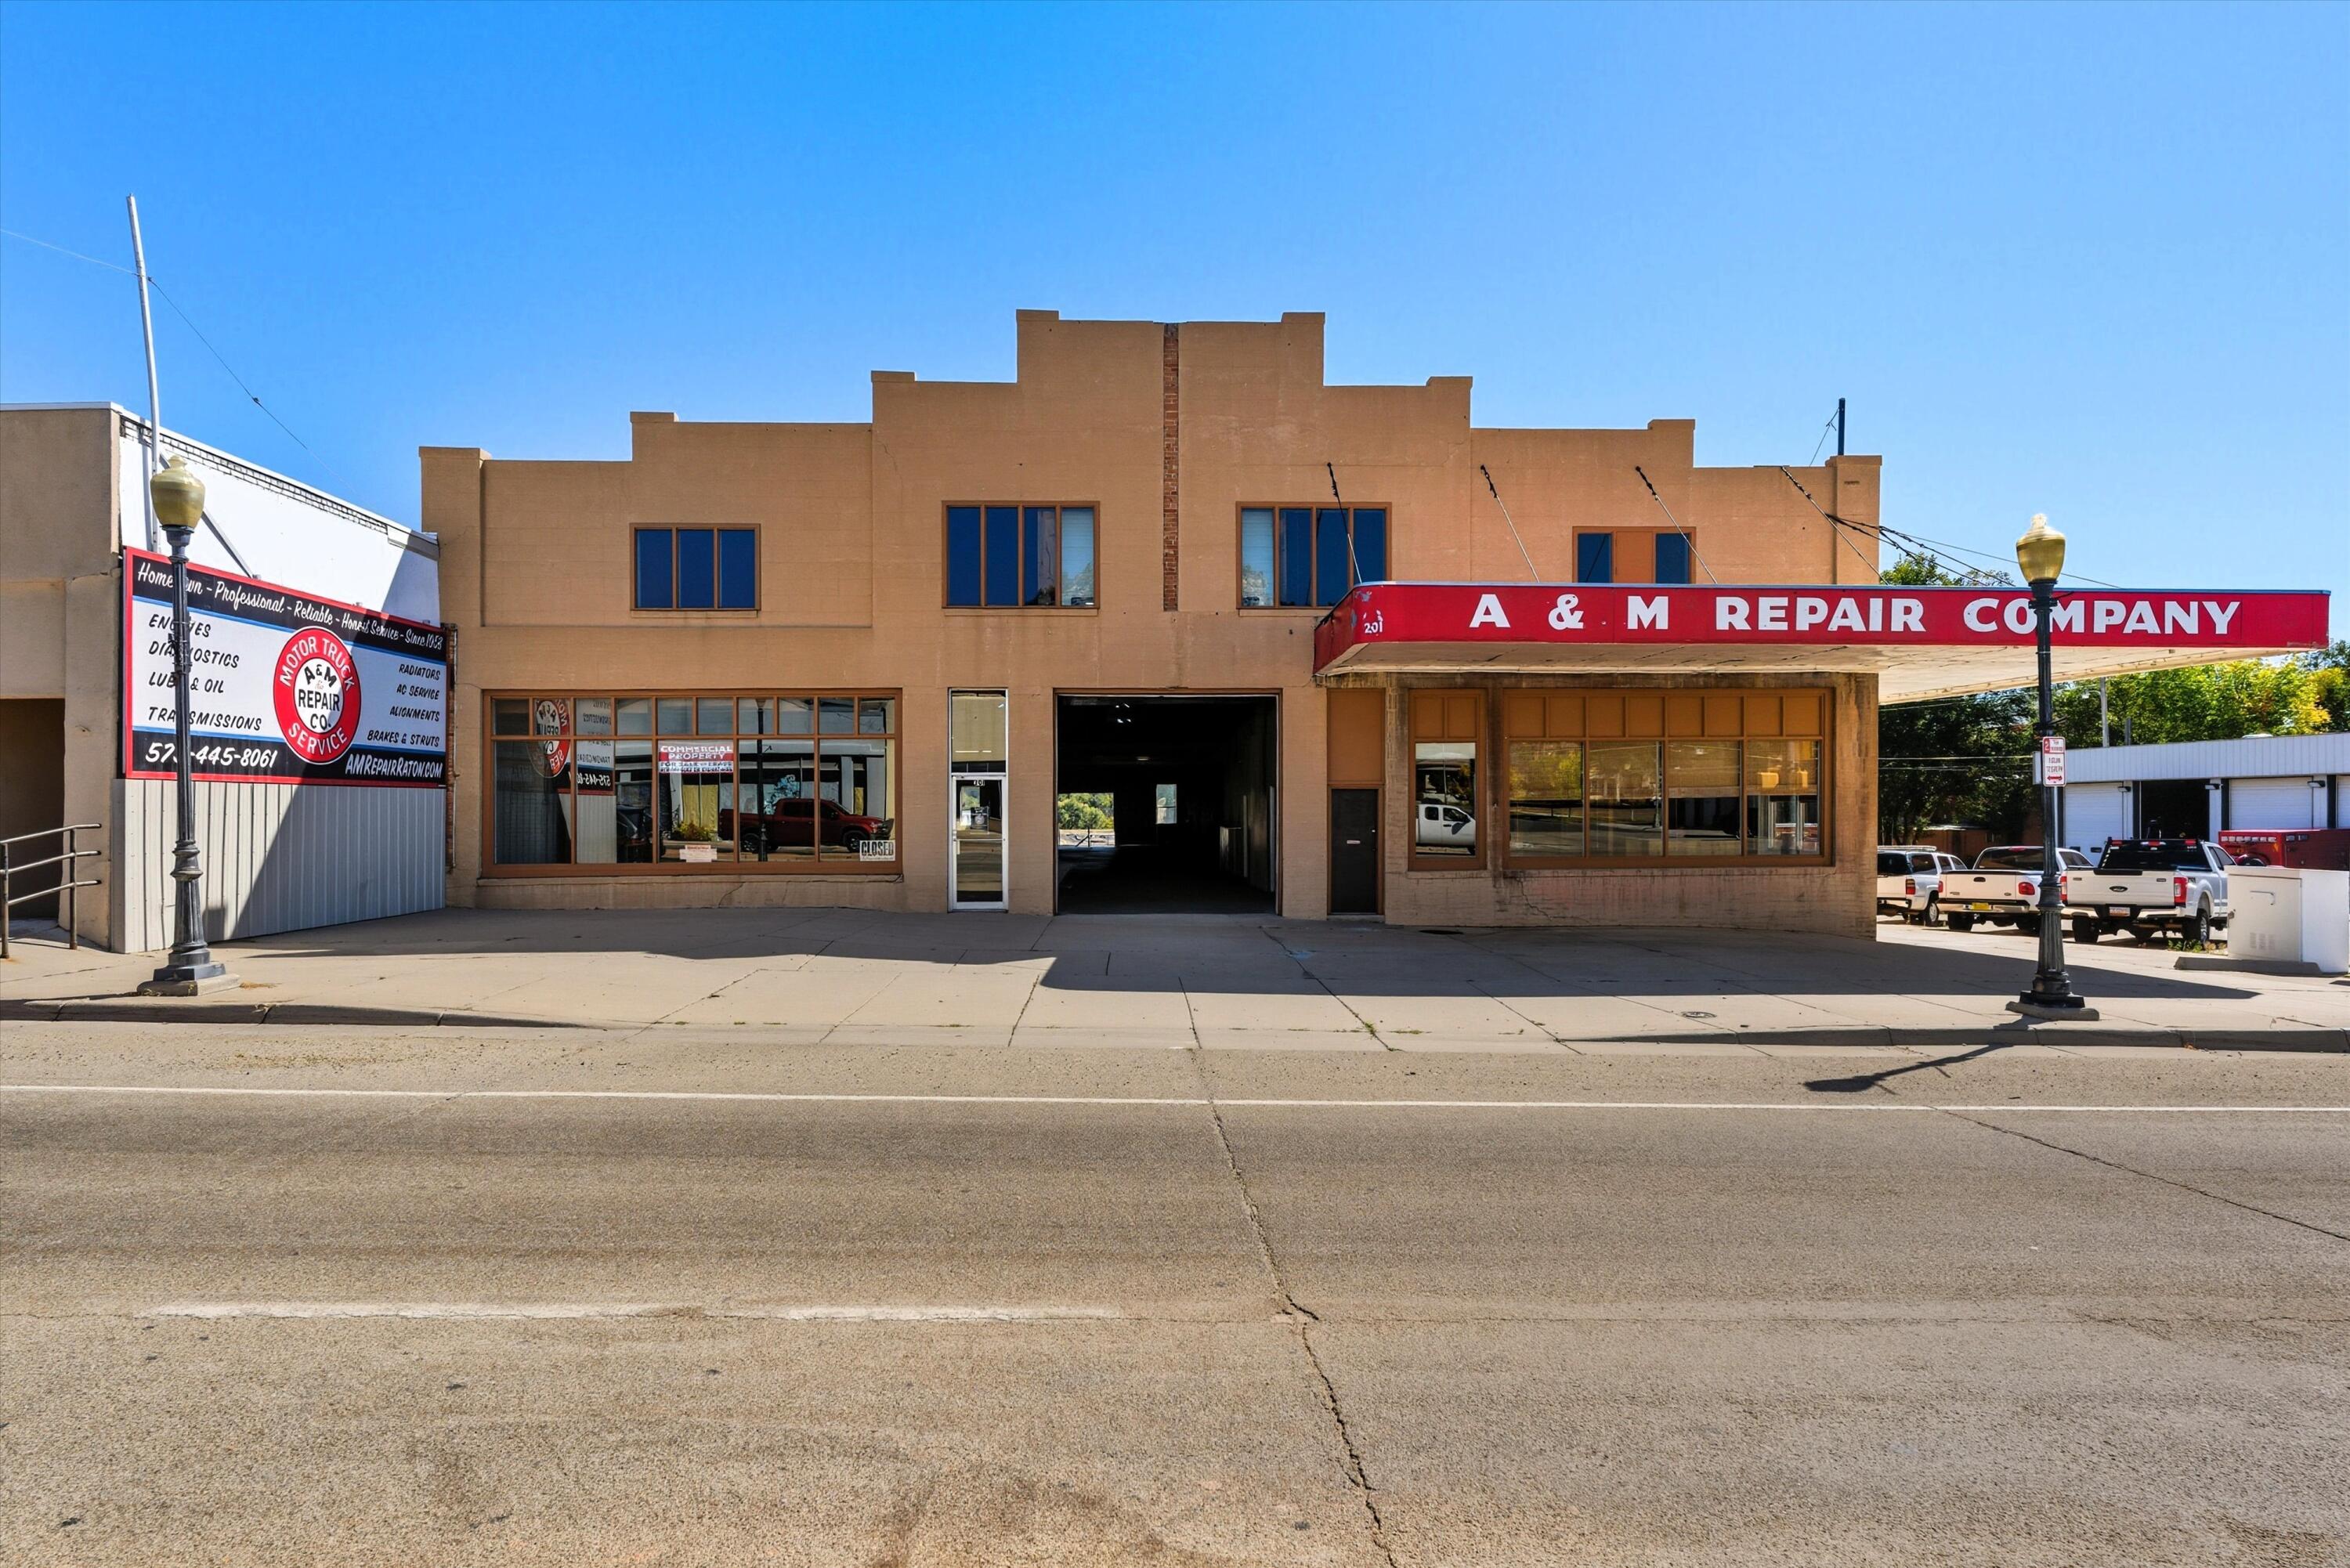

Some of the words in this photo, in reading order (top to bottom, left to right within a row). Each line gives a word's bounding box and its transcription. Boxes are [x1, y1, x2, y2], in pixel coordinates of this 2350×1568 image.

[138, 562, 203, 594] Homewn
[214, 580, 285, 613] Professional
[294, 601, 333, 625] Reliable
[342, 612, 370, 634] Honest
[370, 620, 400, 640] Service
[405, 629, 425, 647] Since
[1470, 594, 1511, 628] A
[1548, 594, 1584, 630] &
[1627, 596, 1668, 630] M
[1716, 596, 1926, 633] REPAIR
[1963, 598, 2241, 634] COMPANY
[149, 614, 212, 638] ENES
[1364, 621, 1383, 634] 201
[149, 641, 240, 668] DIAOSTICS
[280, 636, 318, 687] MOTOR
[322, 638, 355, 692] TRUCK
[149, 671, 179, 688] LUB
[190, 677, 199, 691] &
[204, 678, 224, 693] OIL
[304, 666, 316, 685] A
[316, 664, 323, 676] &
[324, 667, 337, 688] M
[399, 663, 440, 681] RADIATORS
[298, 689, 340, 711] REPAIR
[396, 684, 407, 695] AC
[409, 685, 439, 699] SERVICE
[148, 706, 262, 731] TRASMISSIONS
[310, 714, 331, 731] CO.
[389, 706, 439, 721] ALIGNMENTS
[288, 722, 348, 755] SERVICE
[367, 730, 399, 743] BRAKES
[410, 735, 439, 747] STRUTS
[145, 742, 278, 768] 57-445-8061
[862, 841, 894, 856] CLOSED
